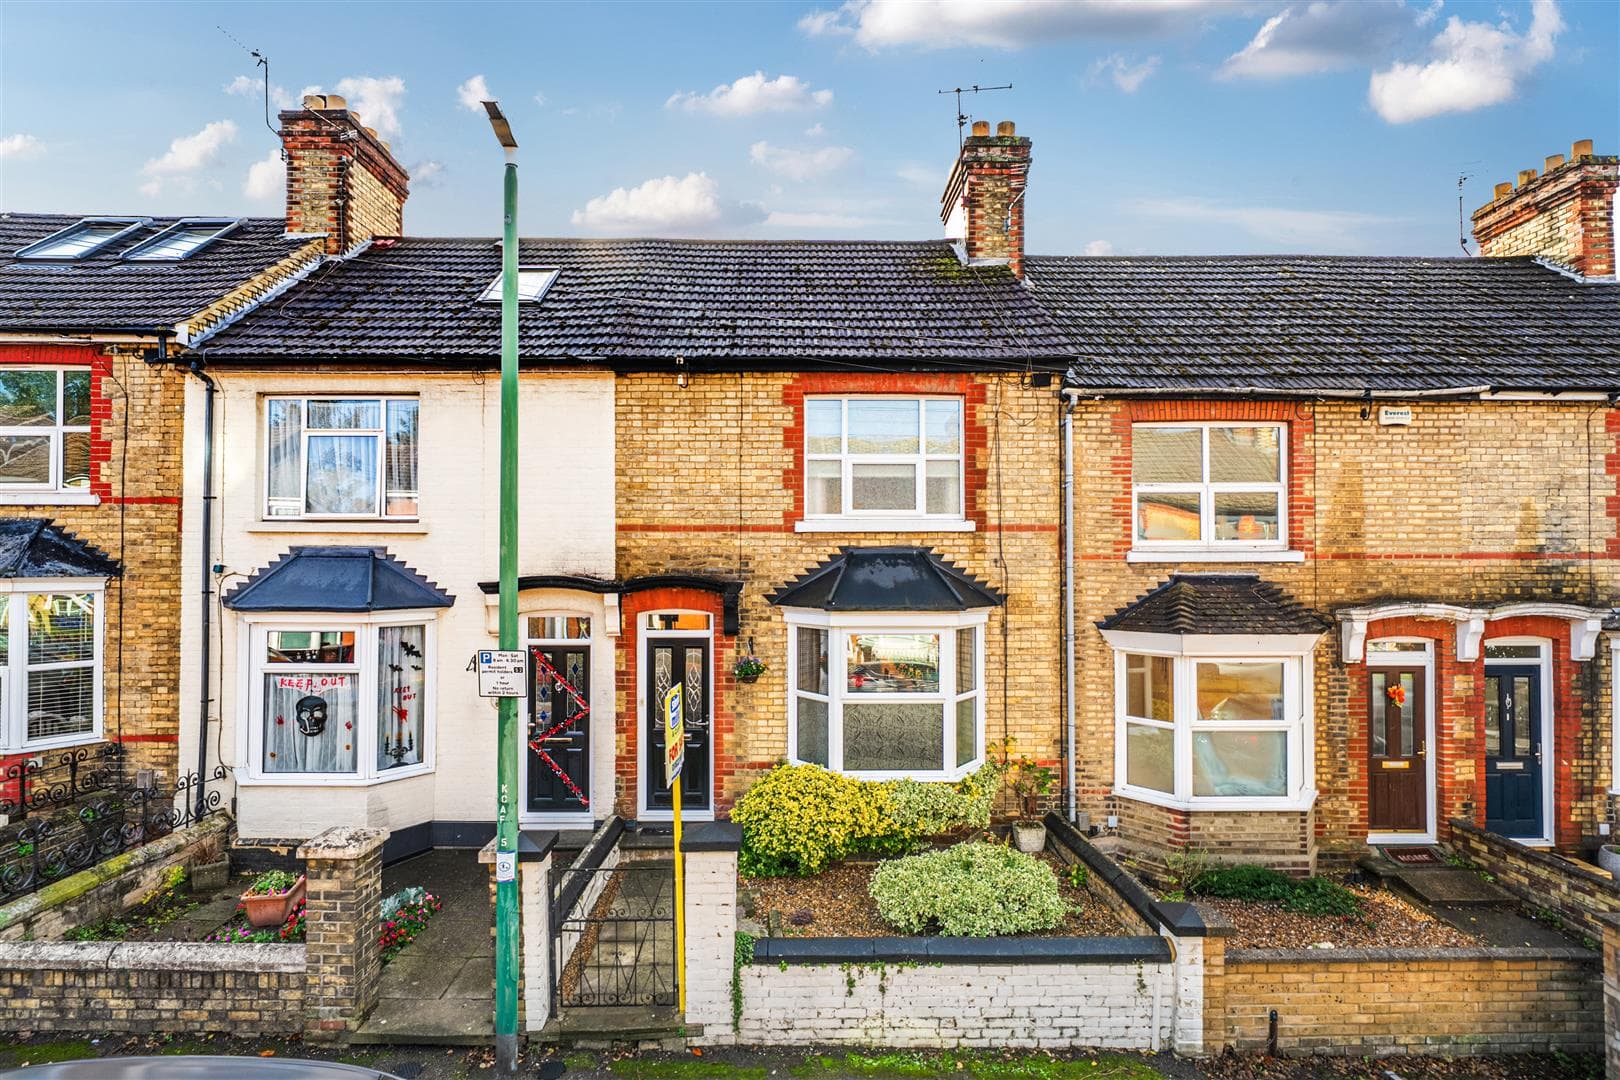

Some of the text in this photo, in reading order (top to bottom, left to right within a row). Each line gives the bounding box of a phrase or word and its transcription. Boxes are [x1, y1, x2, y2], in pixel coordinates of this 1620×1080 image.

[320, 676, 346, 687] OUT
[501, 838, 508, 847] 5
[1397, 854, 1429, 862] HOME
